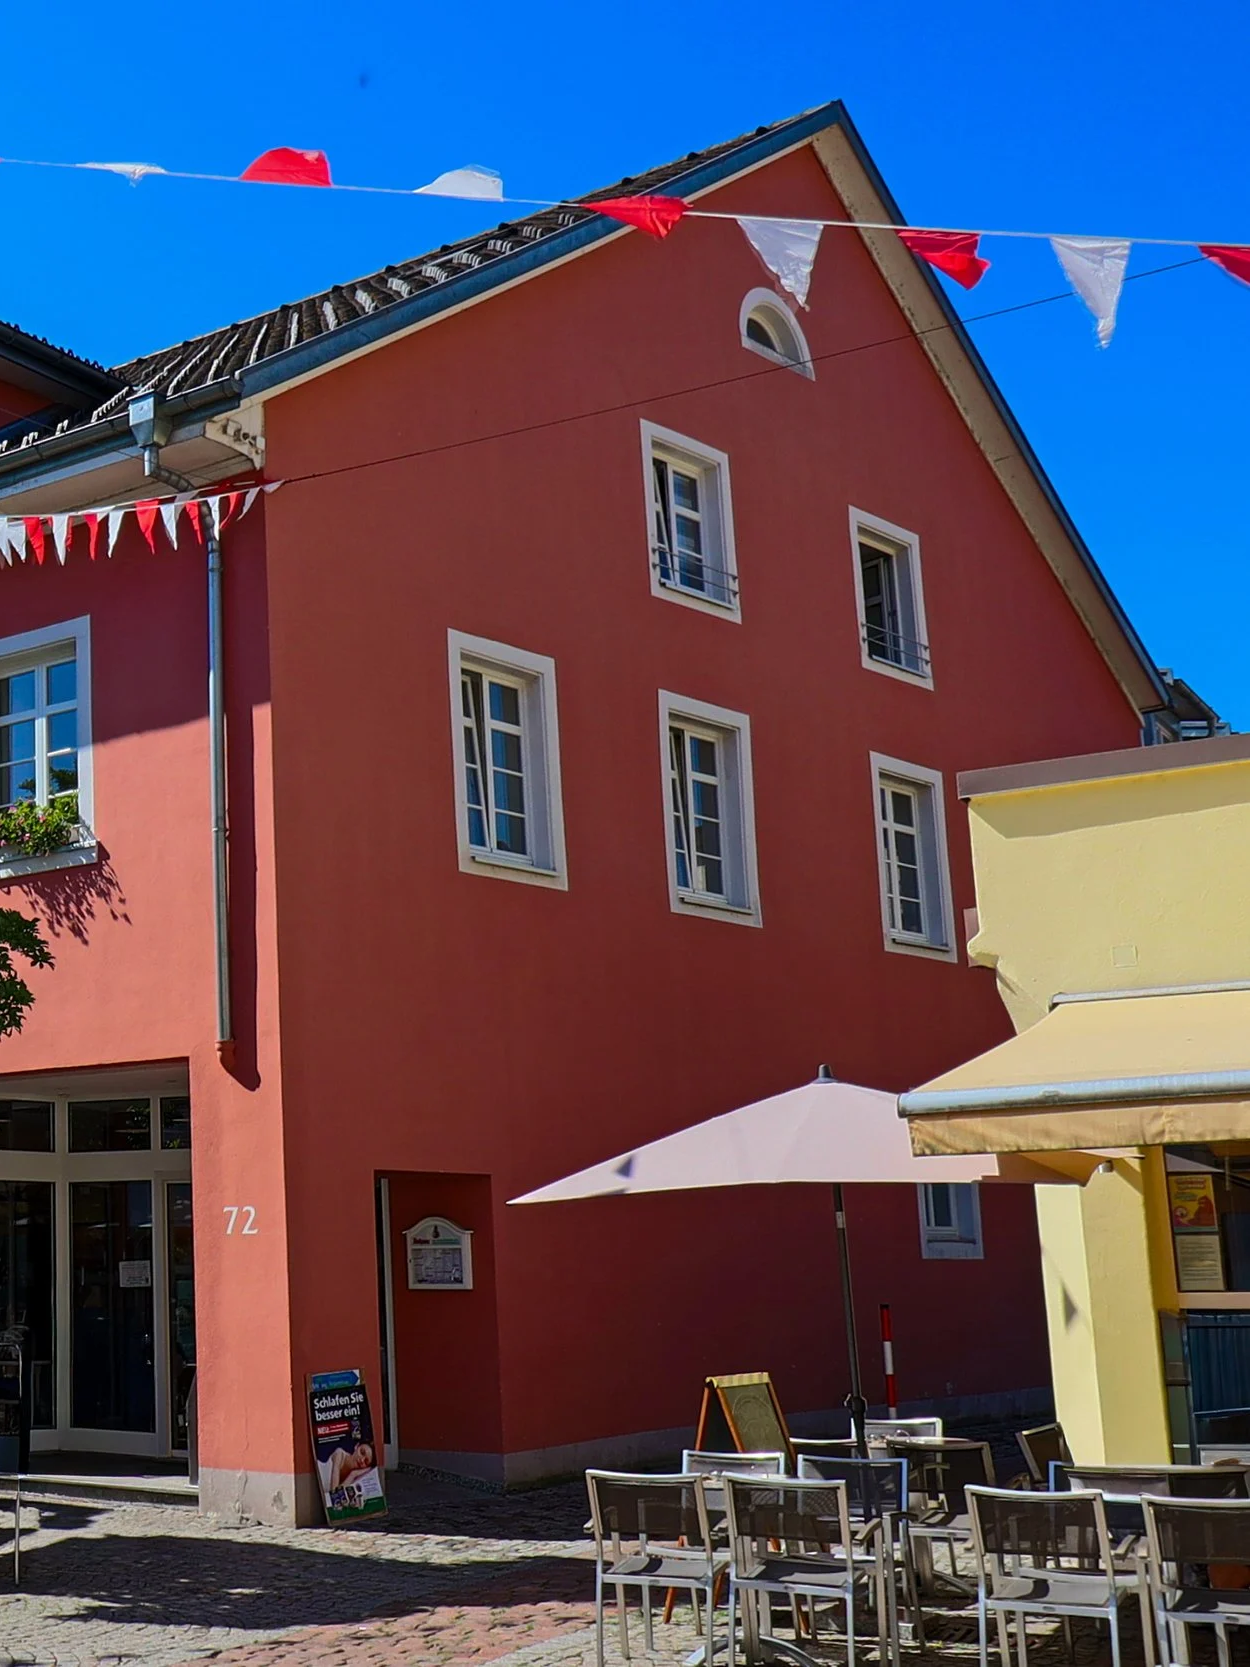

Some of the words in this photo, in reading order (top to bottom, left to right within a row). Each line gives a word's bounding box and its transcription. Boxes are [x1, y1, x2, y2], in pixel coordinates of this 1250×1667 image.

[223, 1206, 259, 1235] 72
[313, 1394, 350, 1410] Schlafen
[350, 1391, 364, 1404] Sie
[314, 1409, 343, 1421] besser
[343, 1404, 361, 1417] ein!
